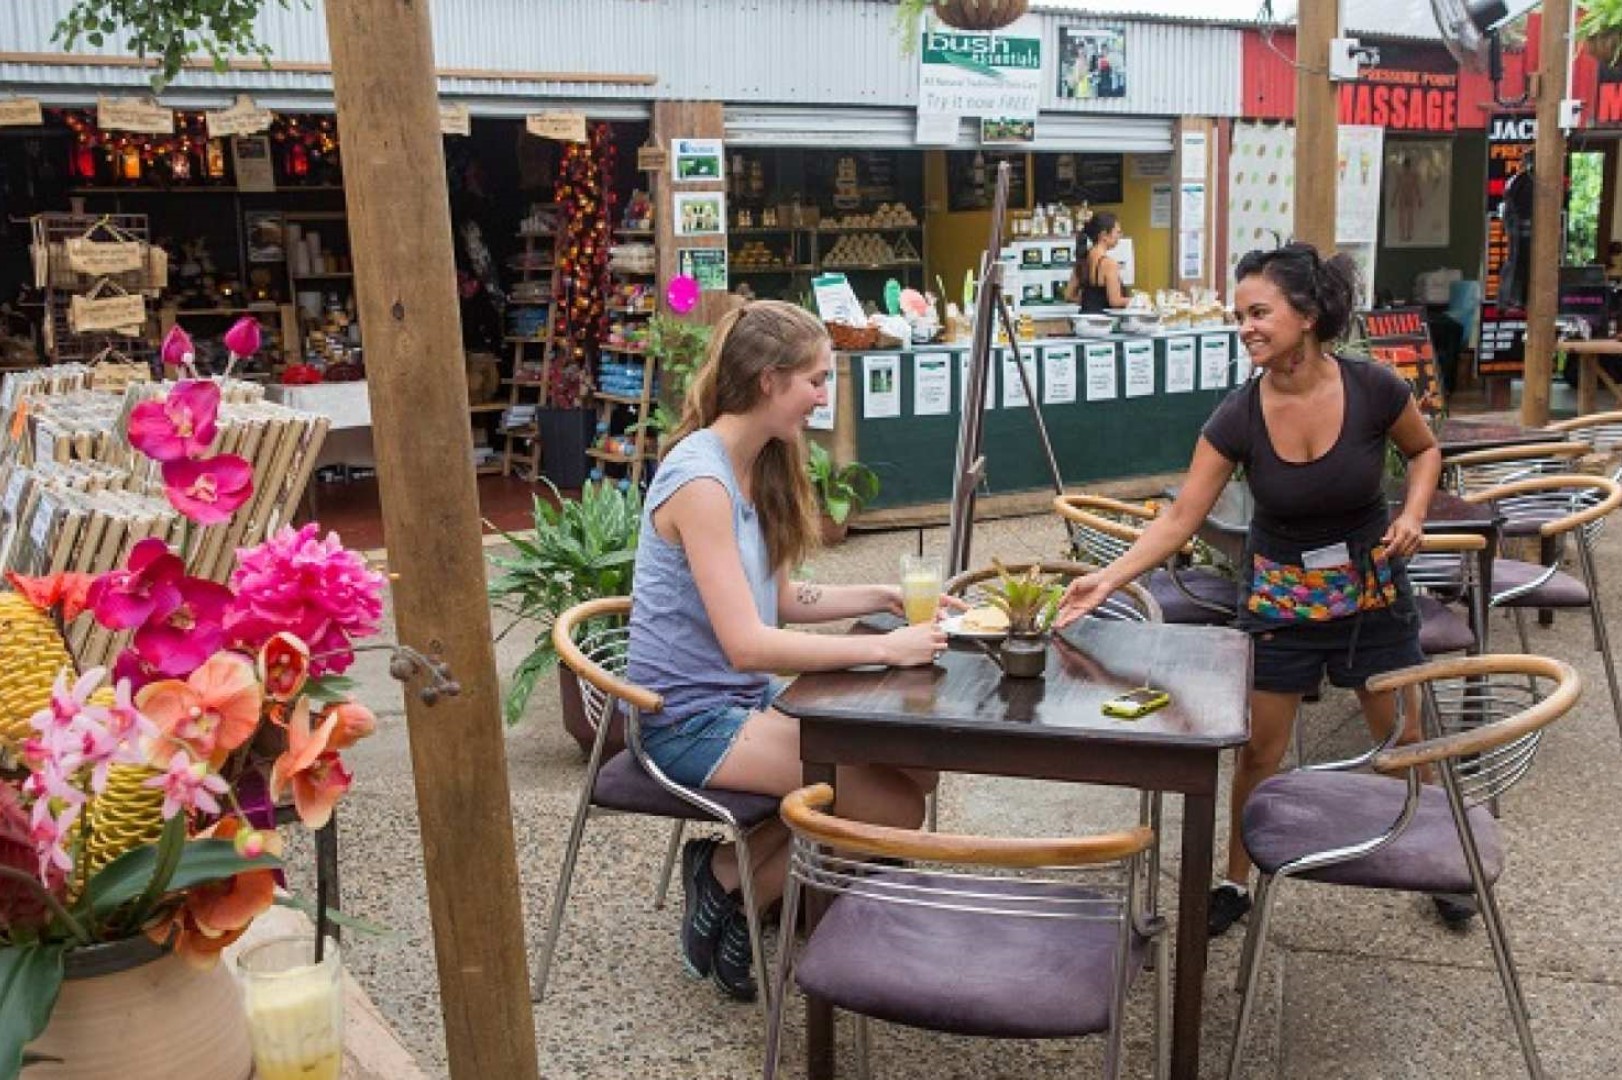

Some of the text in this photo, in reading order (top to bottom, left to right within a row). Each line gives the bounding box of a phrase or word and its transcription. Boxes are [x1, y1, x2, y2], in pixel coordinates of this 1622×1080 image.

[927, 93, 948, 111] Try
[953, 94, 962, 109] it
[966, 97, 994, 109] now
[1338, 82, 1455, 130] MASSAGE
